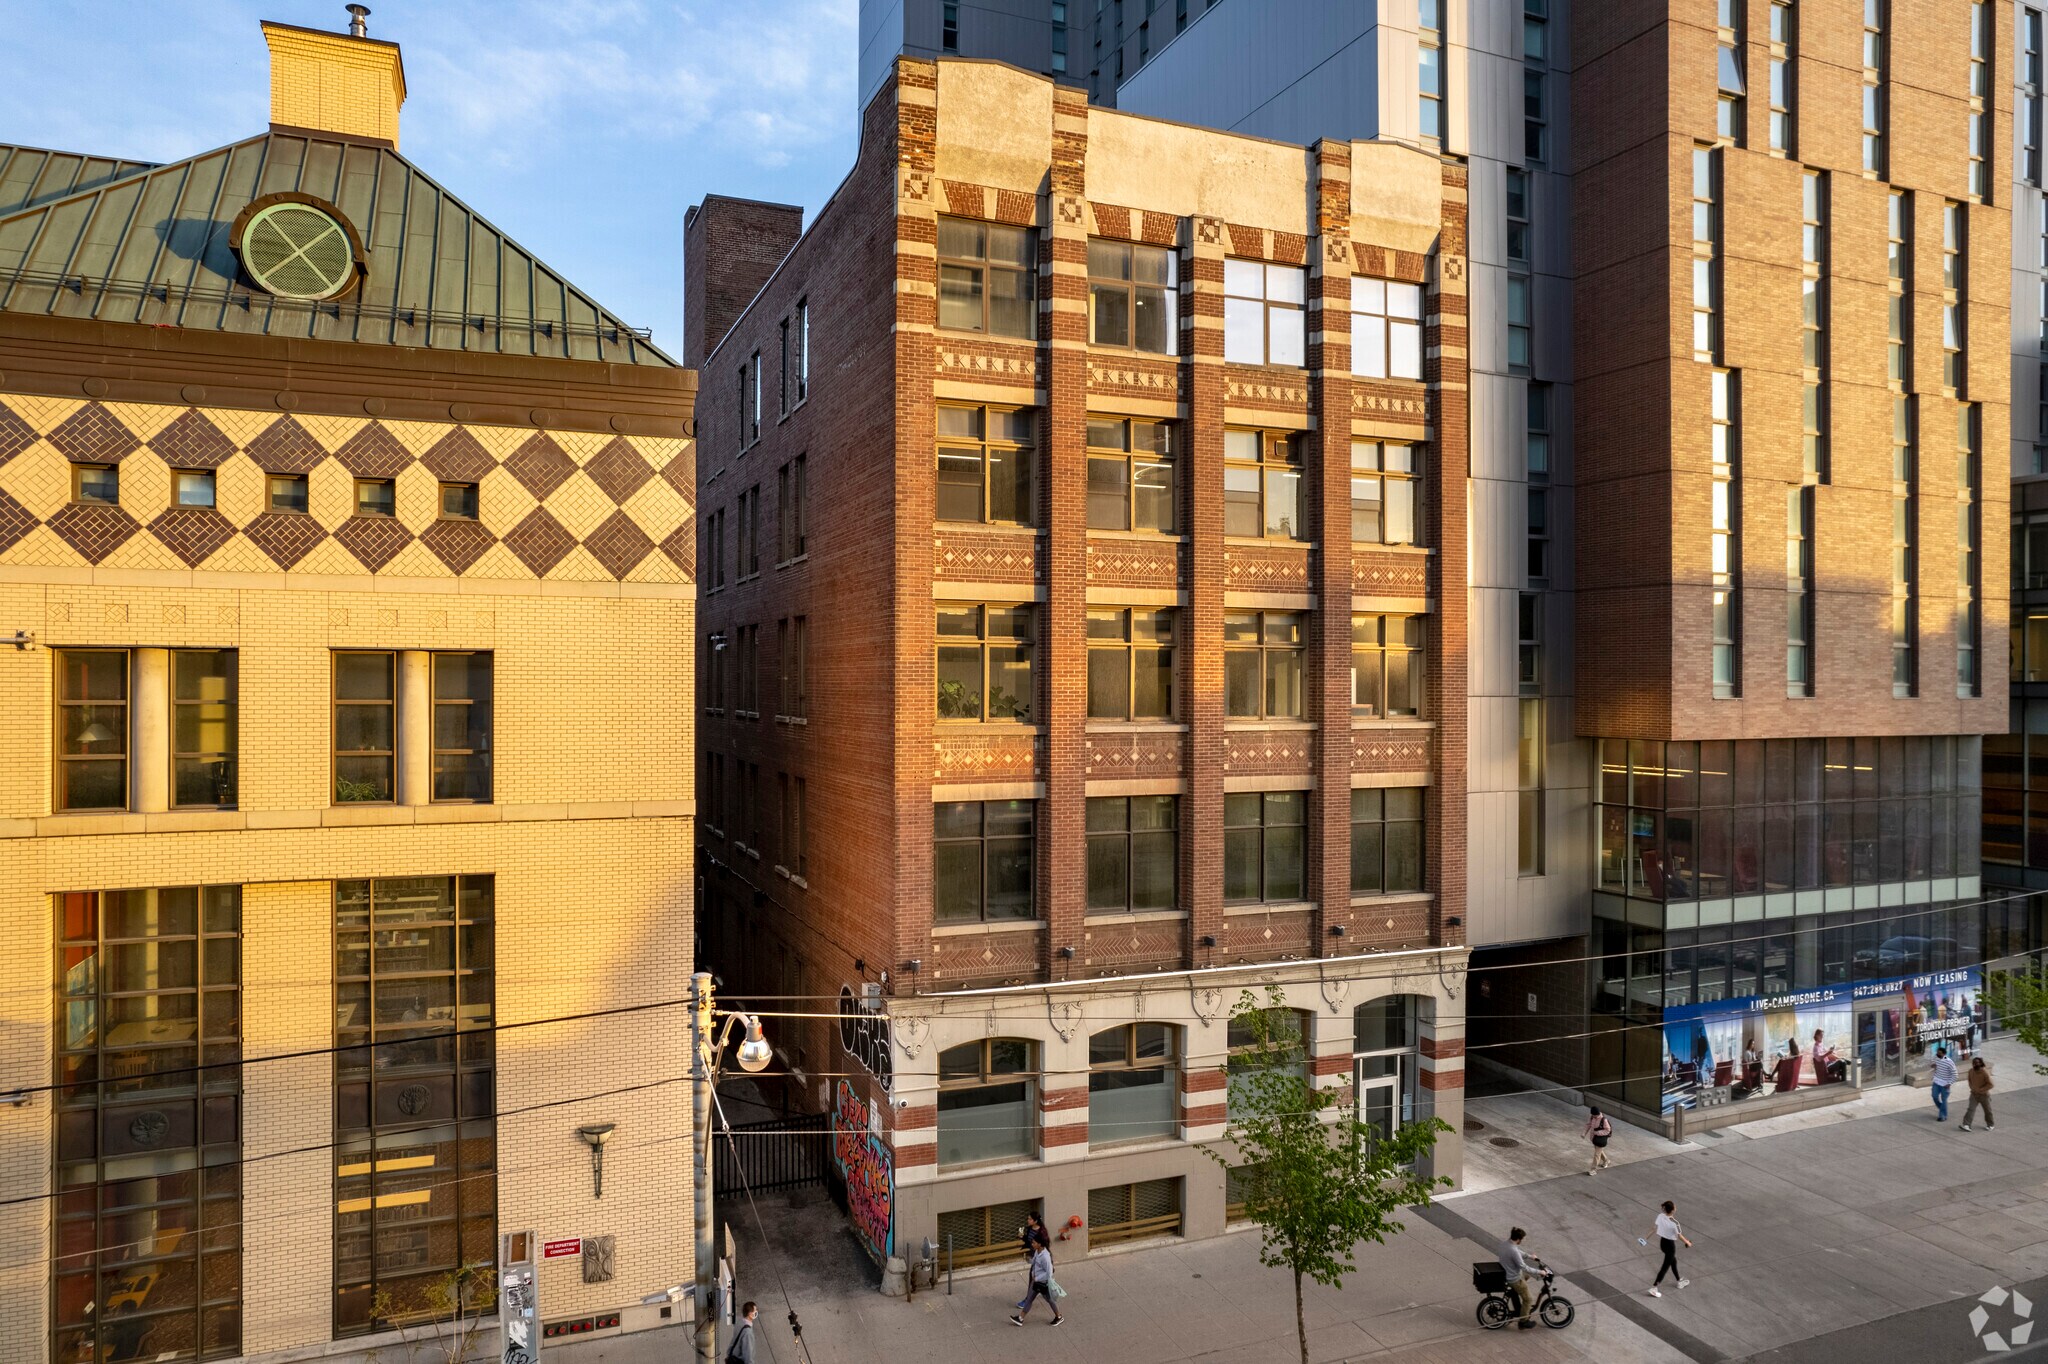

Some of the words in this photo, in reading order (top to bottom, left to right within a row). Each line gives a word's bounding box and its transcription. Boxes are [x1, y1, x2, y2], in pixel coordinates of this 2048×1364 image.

[1913, 976, 1932, 988] NOW
[1935, 970, 1968, 985] LEASING
[1751, 989, 1835, 1011] LIVE-CAMPUSONE.CA
[1920, 1030, 1946, 1042] STUDENT
[555, 1241, 579, 1249] DEPARTMENT
